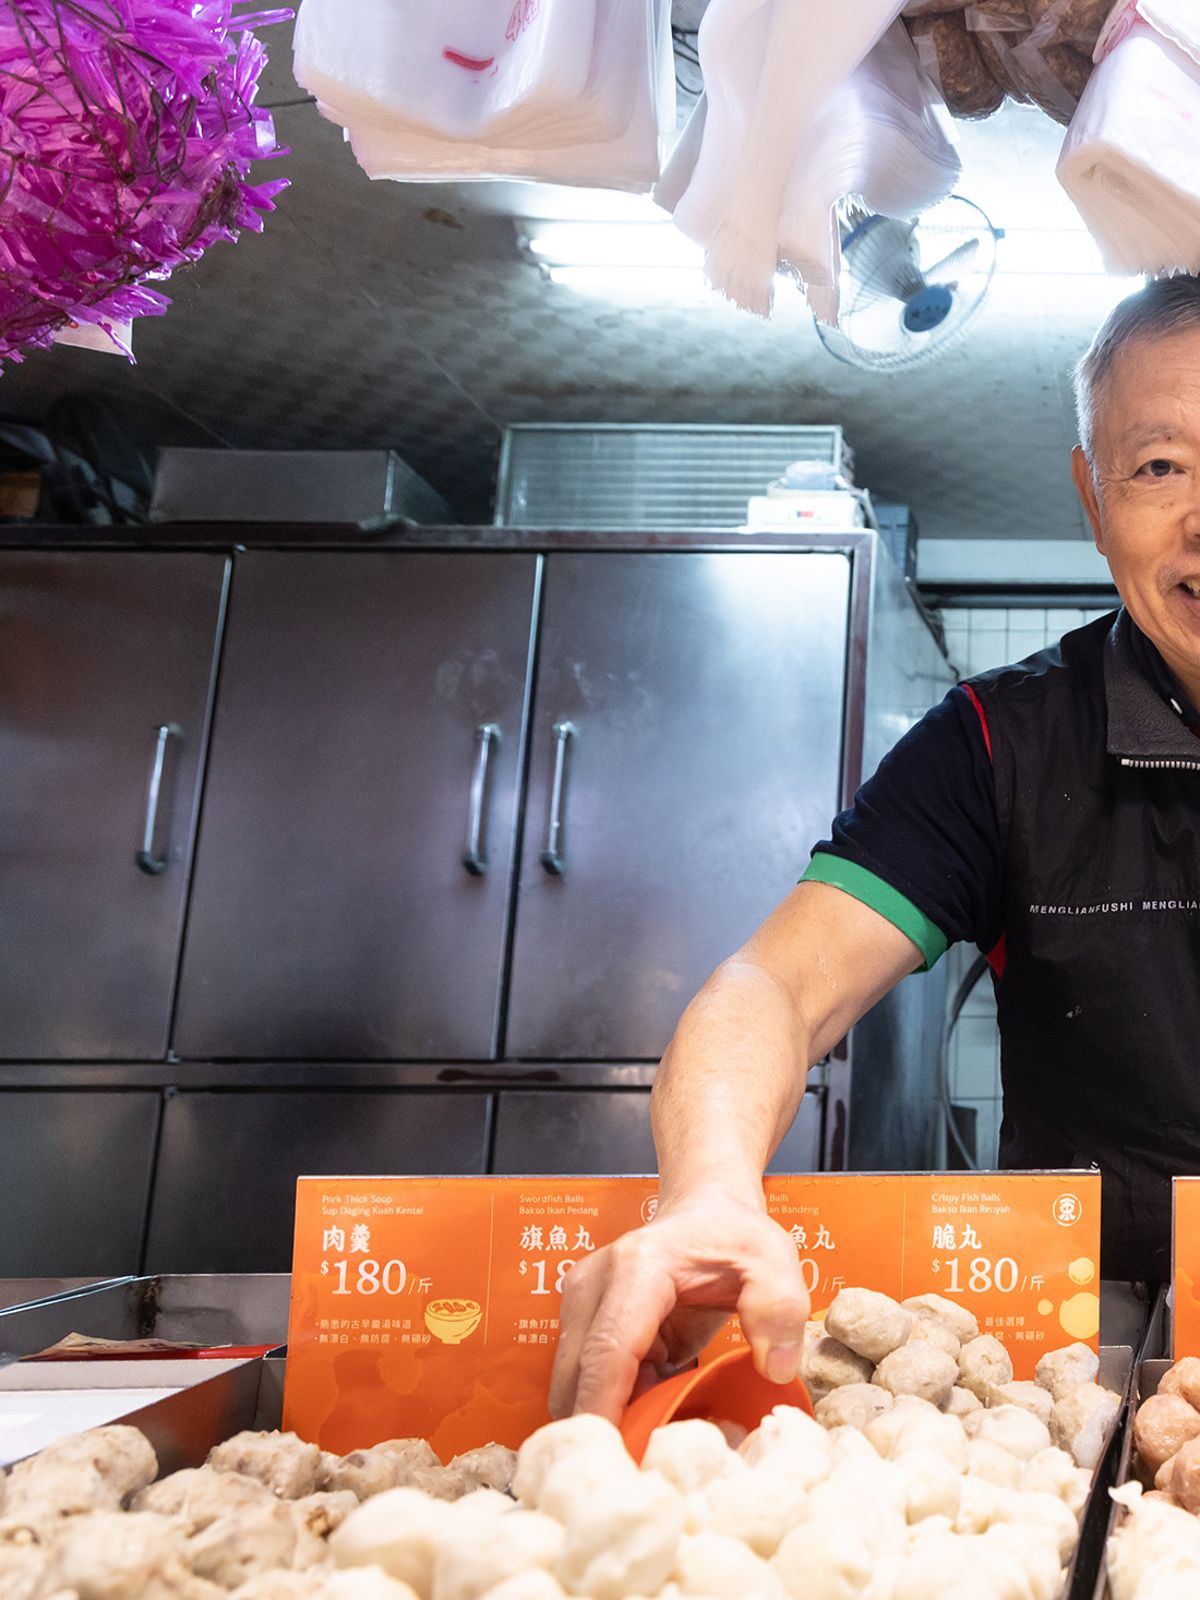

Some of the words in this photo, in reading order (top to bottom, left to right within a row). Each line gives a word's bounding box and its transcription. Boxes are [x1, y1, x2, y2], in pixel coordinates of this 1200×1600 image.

[1029, 901, 1134, 916] MENGLIANFUSHI
[322, 1195, 341, 1203] Pork
[345, 1195, 369, 1203] Thick
[371, 1195, 393, 1206] Soup
[520, 1195, 562, 1203] Swordfish
[565, 1195, 584, 1203] Balls
[769, 1193, 790, 1203] Balls
[931, 1193, 959, 1204] Crispy
[962, 1193, 979, 1202] Fish
[981, 1193, 1001, 1202] Balls
[322, 1207, 338, 1217] Sup
[340, 1207, 370, 1217] Daging
[372, 1207, 394, 1215] Kuah
[396, 1207, 423, 1215] Kental
[519, 1207, 544, 1215] Bakso
[547, 1207, 565, 1215] Ikan
[567, 1207, 598, 1217] Pedang
[781, 1205, 819, 1216] Bandeng
[932, 1205, 957, 1214] Bakso
[960, 1205, 977, 1213] Ikan
[322, 1223, 371, 1253] 肉羹
[519, 1224, 596, 1252] 旗魚丸
[788, 1223, 836, 1250] 魚丸
[931, 1223, 982, 1250] 脆丸
